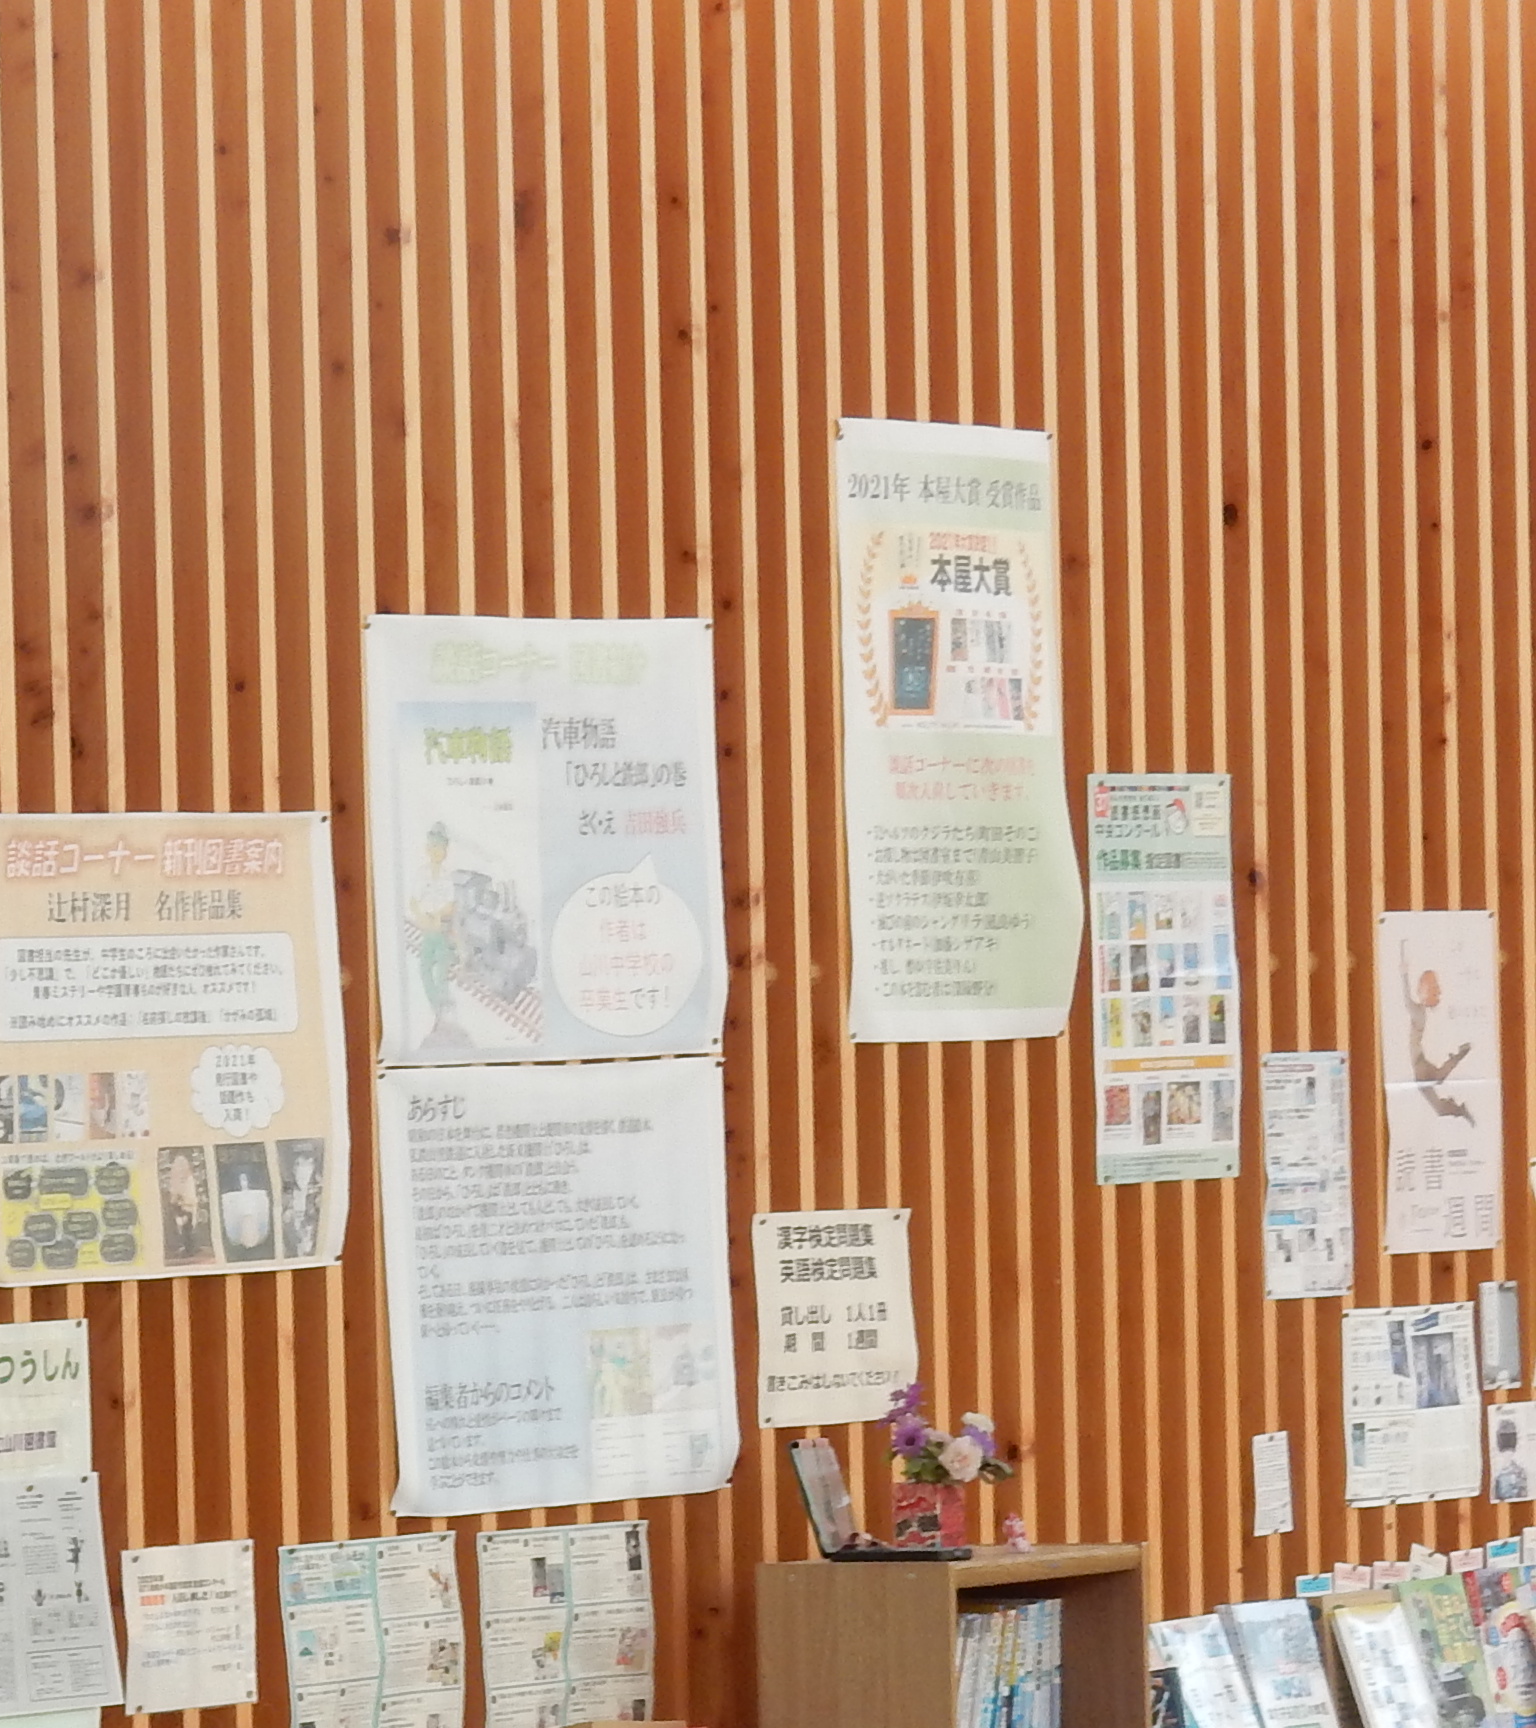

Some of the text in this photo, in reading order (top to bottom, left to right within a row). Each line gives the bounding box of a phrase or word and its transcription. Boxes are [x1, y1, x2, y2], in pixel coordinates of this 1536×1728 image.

[848, 473, 911, 502] 2021年
[918, 474, 981, 507] 本屋大賞
[930, 553, 1012, 596] 本屋大賞
[541, 716, 617, 750] 汽車物語
[6, 839, 156, 878] 談話コーナー
[47, 889, 243, 923] 辻村深月 名作作品集
[407, 1094, 466, 1123] あらすじ
[776, 1223, 874, 1250] 漢字検定問題集
[779, 1256, 879, 1283] 英語検定問題集
[780, 1304, 832, 1327] 貸し出し
[425, 1375, 556, 1411] 編集者からのコメント
